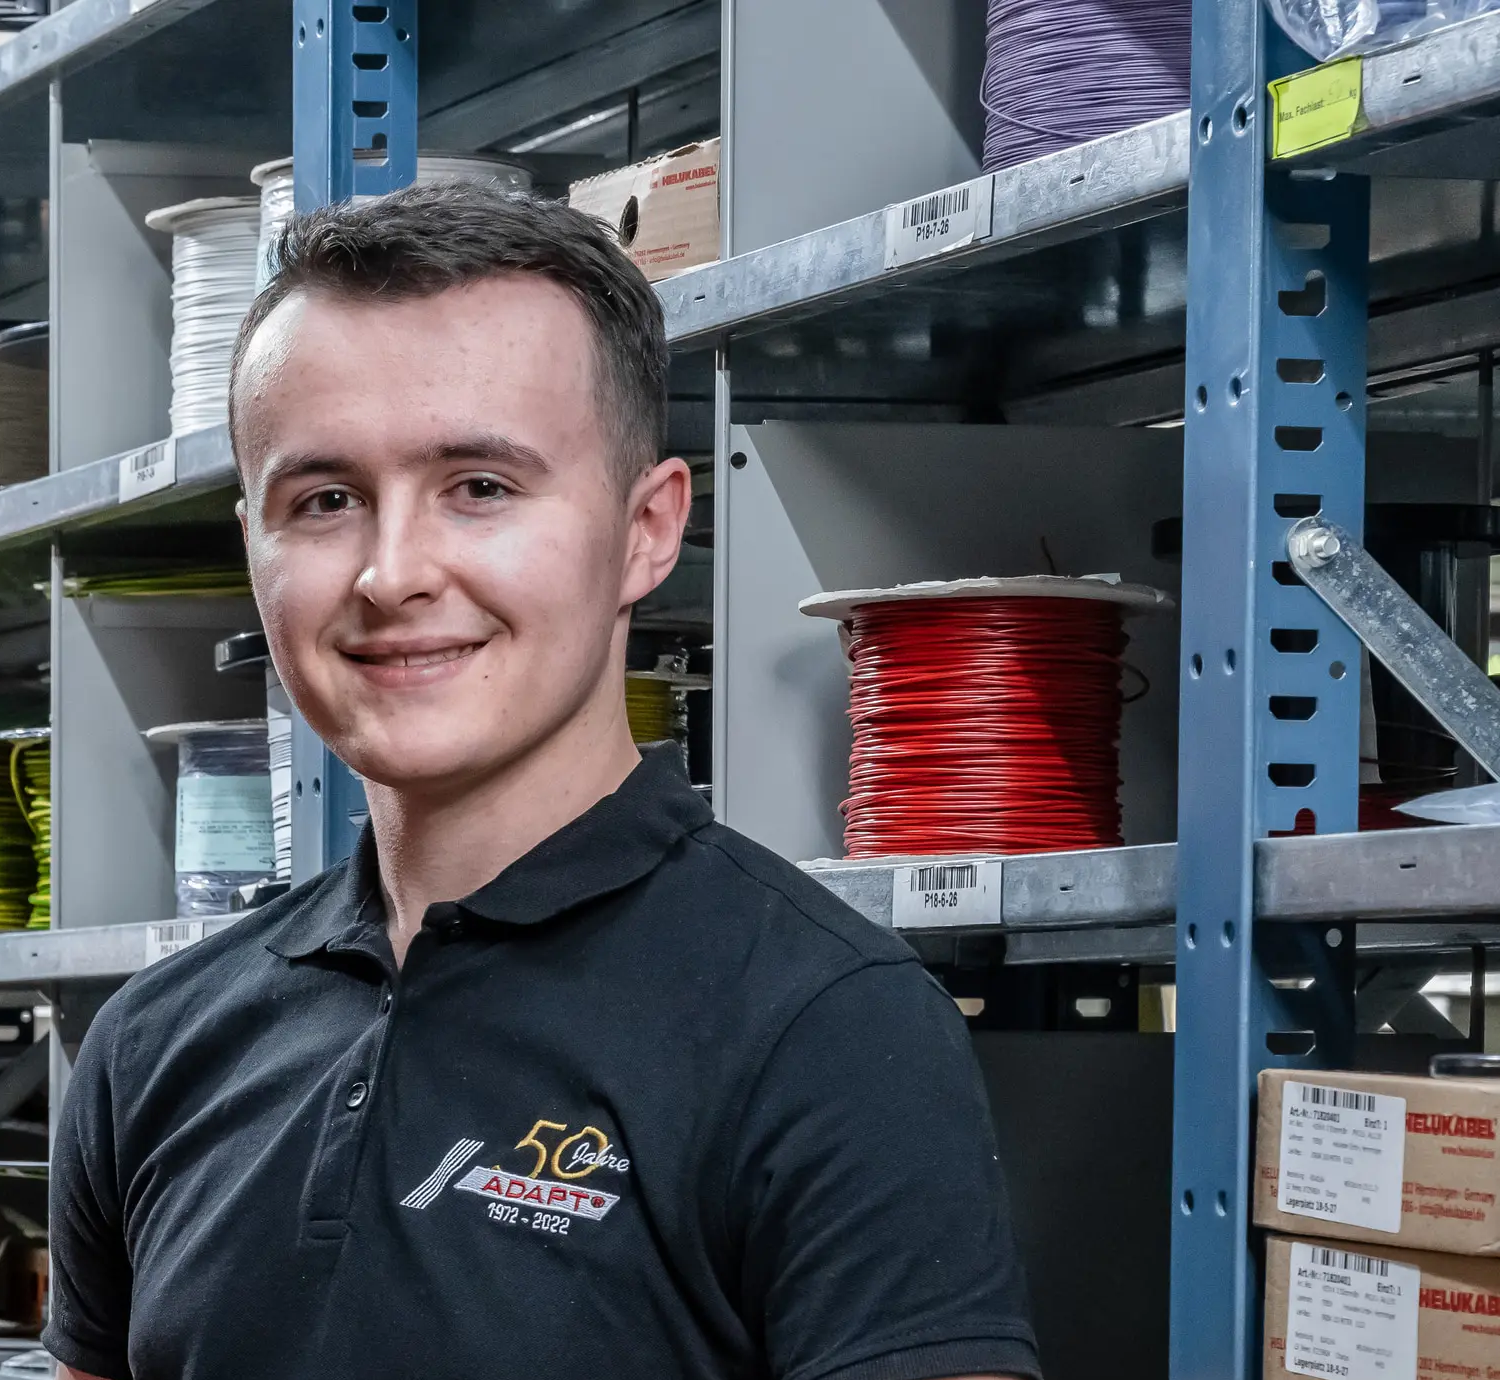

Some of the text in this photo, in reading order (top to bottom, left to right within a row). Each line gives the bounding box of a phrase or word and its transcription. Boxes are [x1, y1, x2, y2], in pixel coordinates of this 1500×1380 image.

[916, 218, 949, 242] P18-7-26
[924, 891, 958, 909] P18-6-26
[492, 1119, 631, 1180] 50 Jahre
[487, 1202, 519, 1224] 1972
[532, 1212, 571, 1235] 2022
